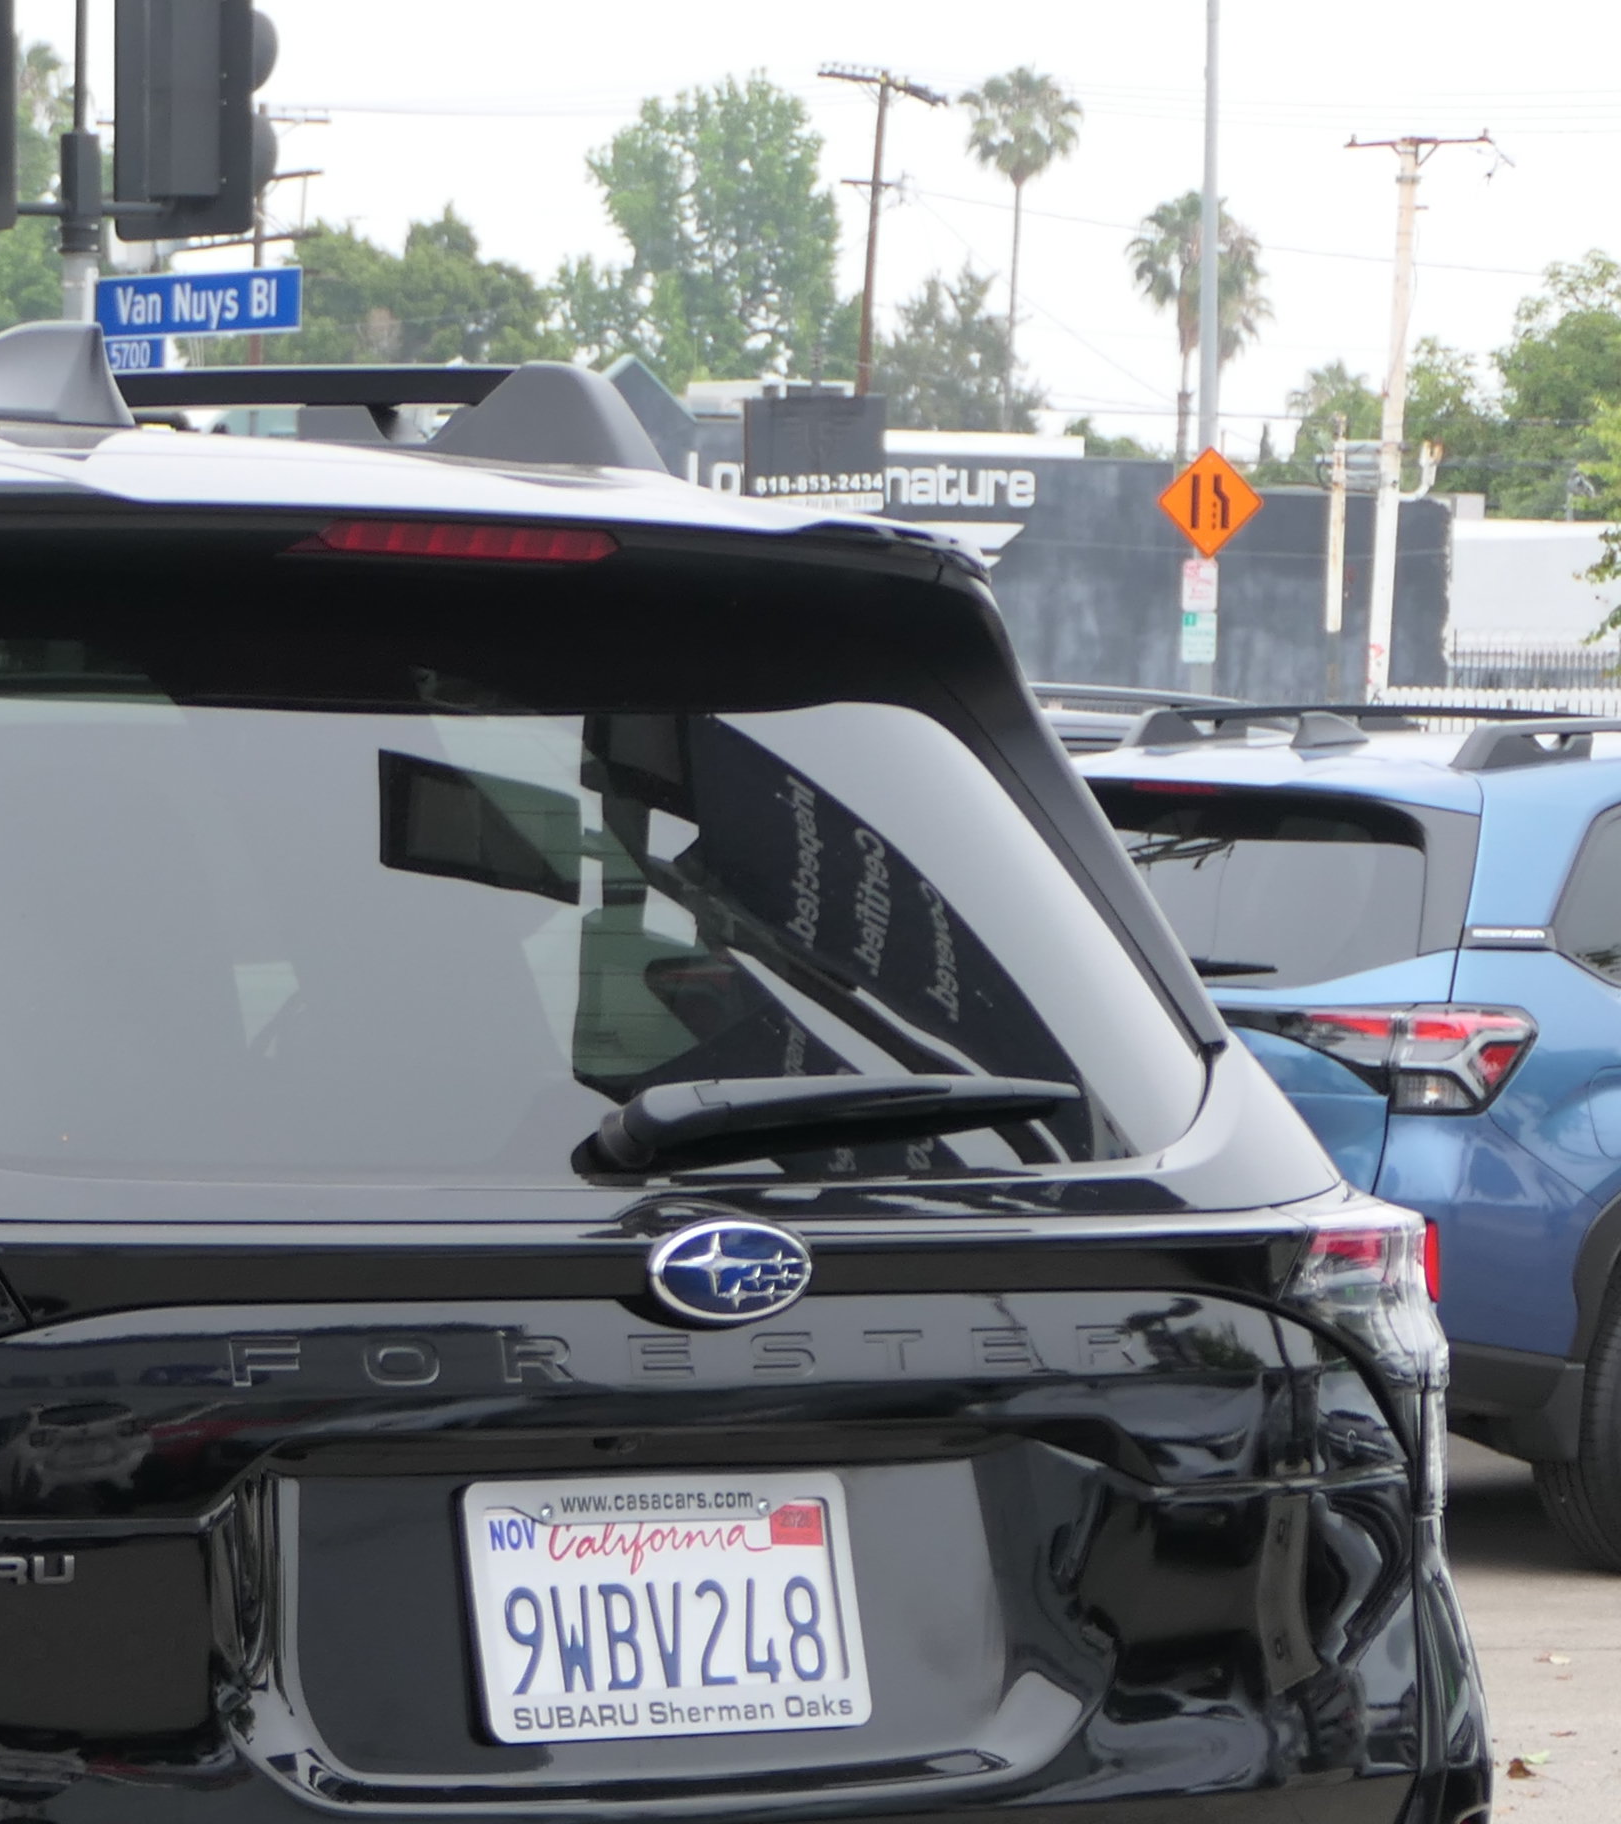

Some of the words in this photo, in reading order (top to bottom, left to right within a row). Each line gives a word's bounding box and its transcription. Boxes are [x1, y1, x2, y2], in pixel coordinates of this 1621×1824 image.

[115, 285, 163, 326] Van
[172, 281, 240, 331] Nuys
[109, 340, 151, 370] 5700
[885, 462, 1037, 508] nature
[229, 1326, 1137, 1388] FORESTER
[560, 1488, 754, 1514] www.casacars.com
[488, 1518, 537, 1552] NOV
[547, 1522, 772, 1575] California
[503, 1575, 827, 1696] 9WBV248
[513, 1703, 639, 1731] SUBARU
[649, 1698, 774, 1725] Sherman
[784, 1695, 854, 1718] Oaks
